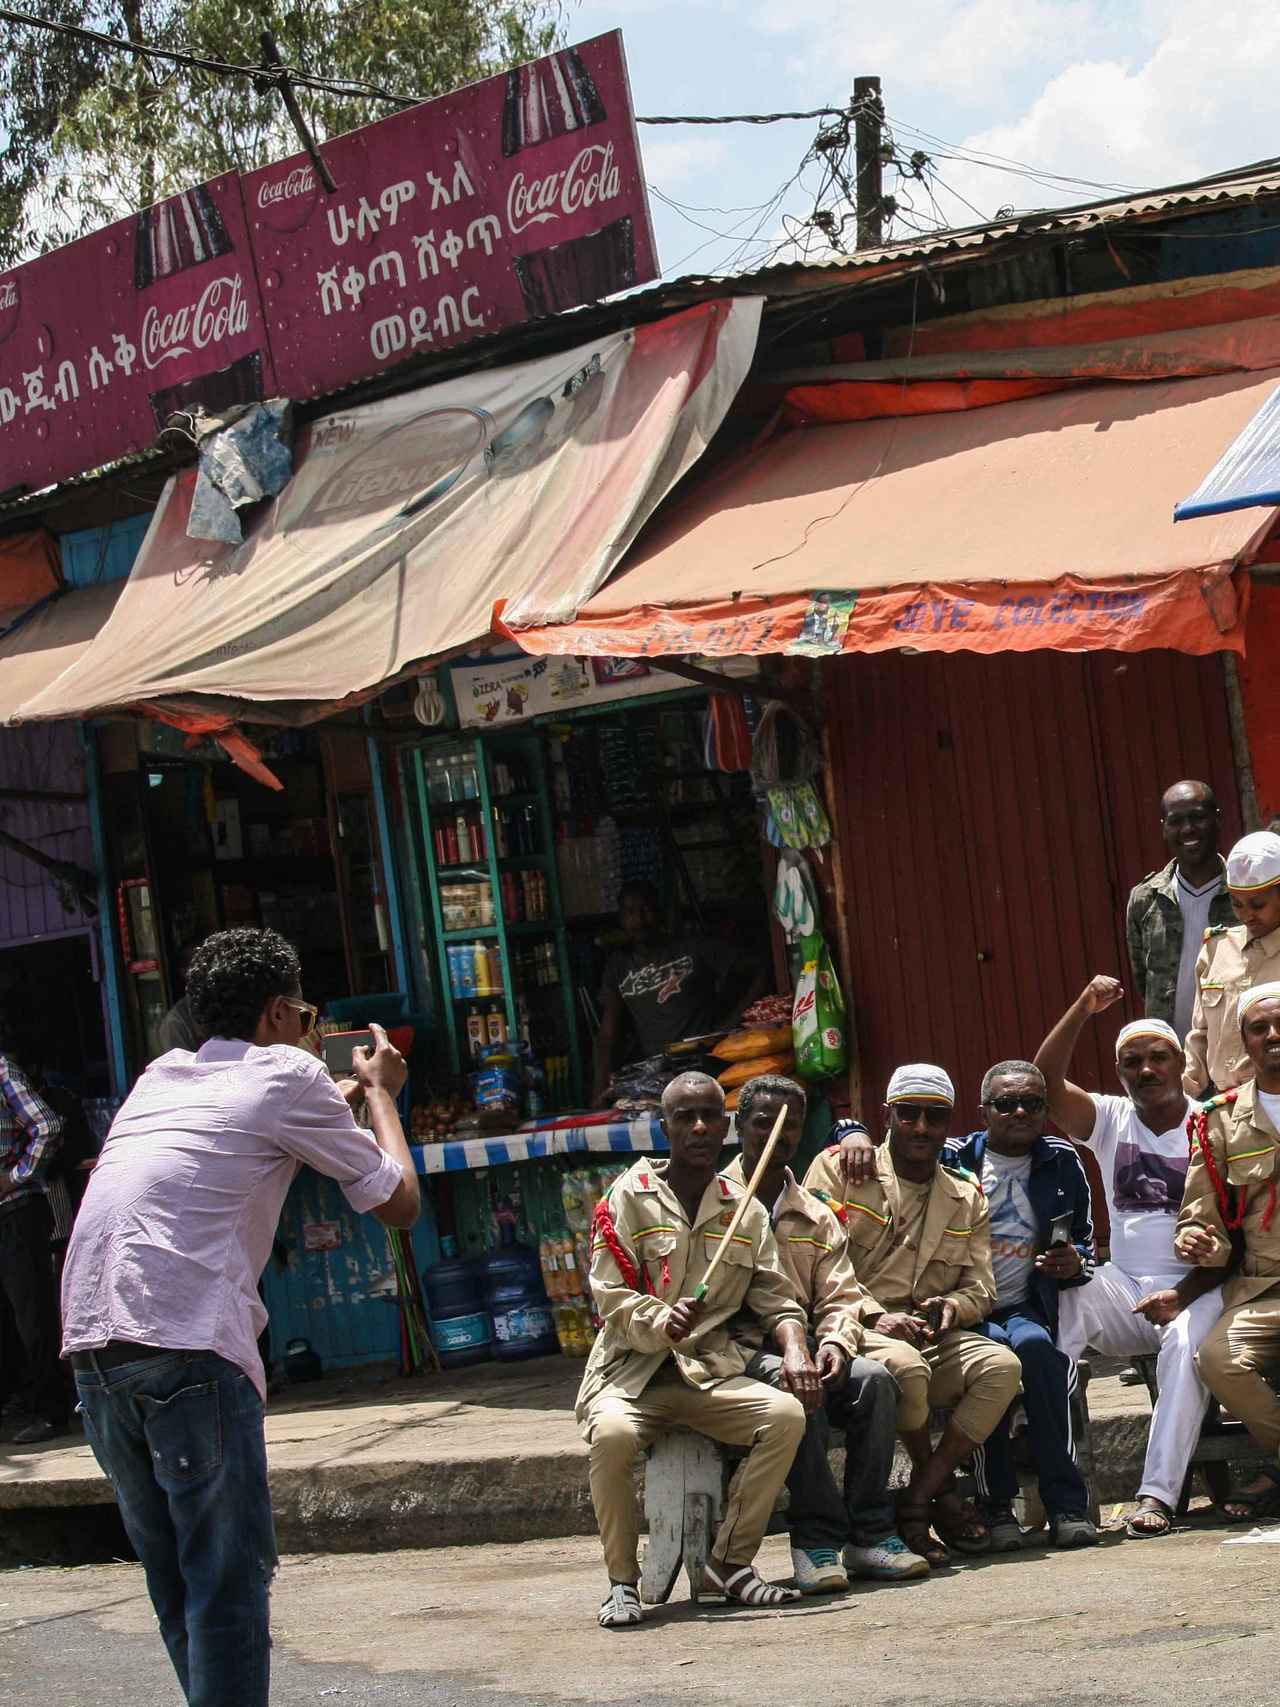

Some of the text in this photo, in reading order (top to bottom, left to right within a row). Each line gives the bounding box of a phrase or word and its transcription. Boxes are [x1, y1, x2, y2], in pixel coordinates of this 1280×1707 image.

[257, 164, 315, 208] Coca-Cola
[327, 160, 475, 247] ሁሉም አለ
[506, 141, 621, 234] Coca-Cola
[141, 273, 249, 370] Coca-Cola
[370, 286, 486, 360] መደብር
[313, 421, 356, 449] NEW
[894, 592, 1149, 631] JOYE COLECTION
